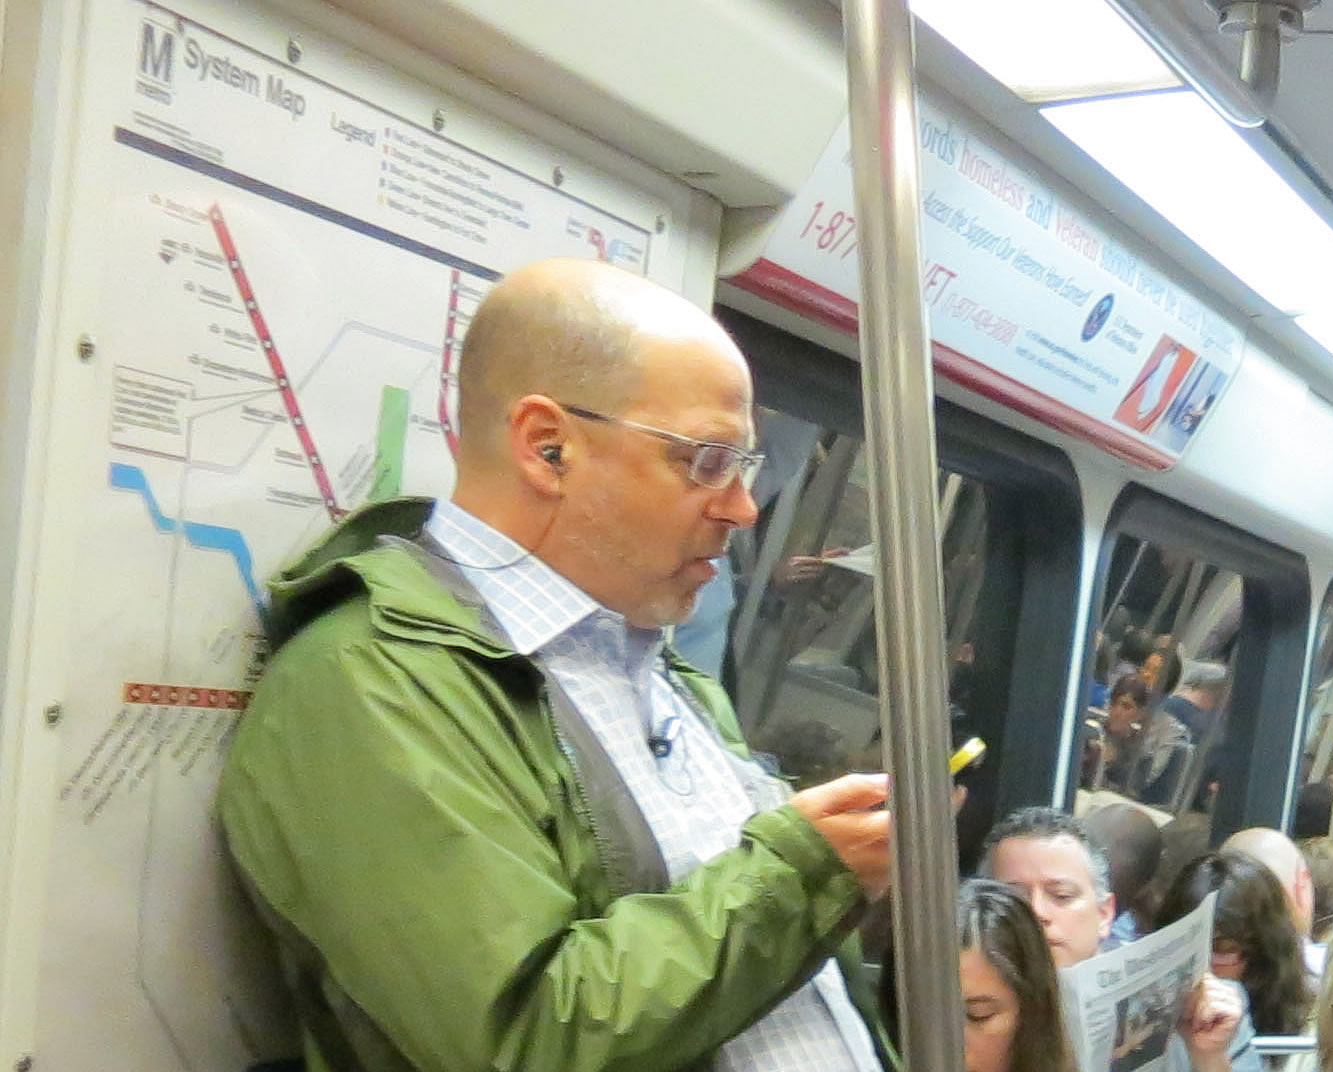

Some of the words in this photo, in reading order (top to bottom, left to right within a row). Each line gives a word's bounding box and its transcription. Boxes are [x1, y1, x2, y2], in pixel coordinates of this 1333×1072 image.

[141, 23, 174, 82] M
[183, 36, 260, 97] System
[265, 74, 306, 122] Map
[330, 111, 377, 147] Legend
[920, 118, 955, 166] ords
[959, 134, 1024, 210] homeless
[1025, 190, 1053, 231] and
